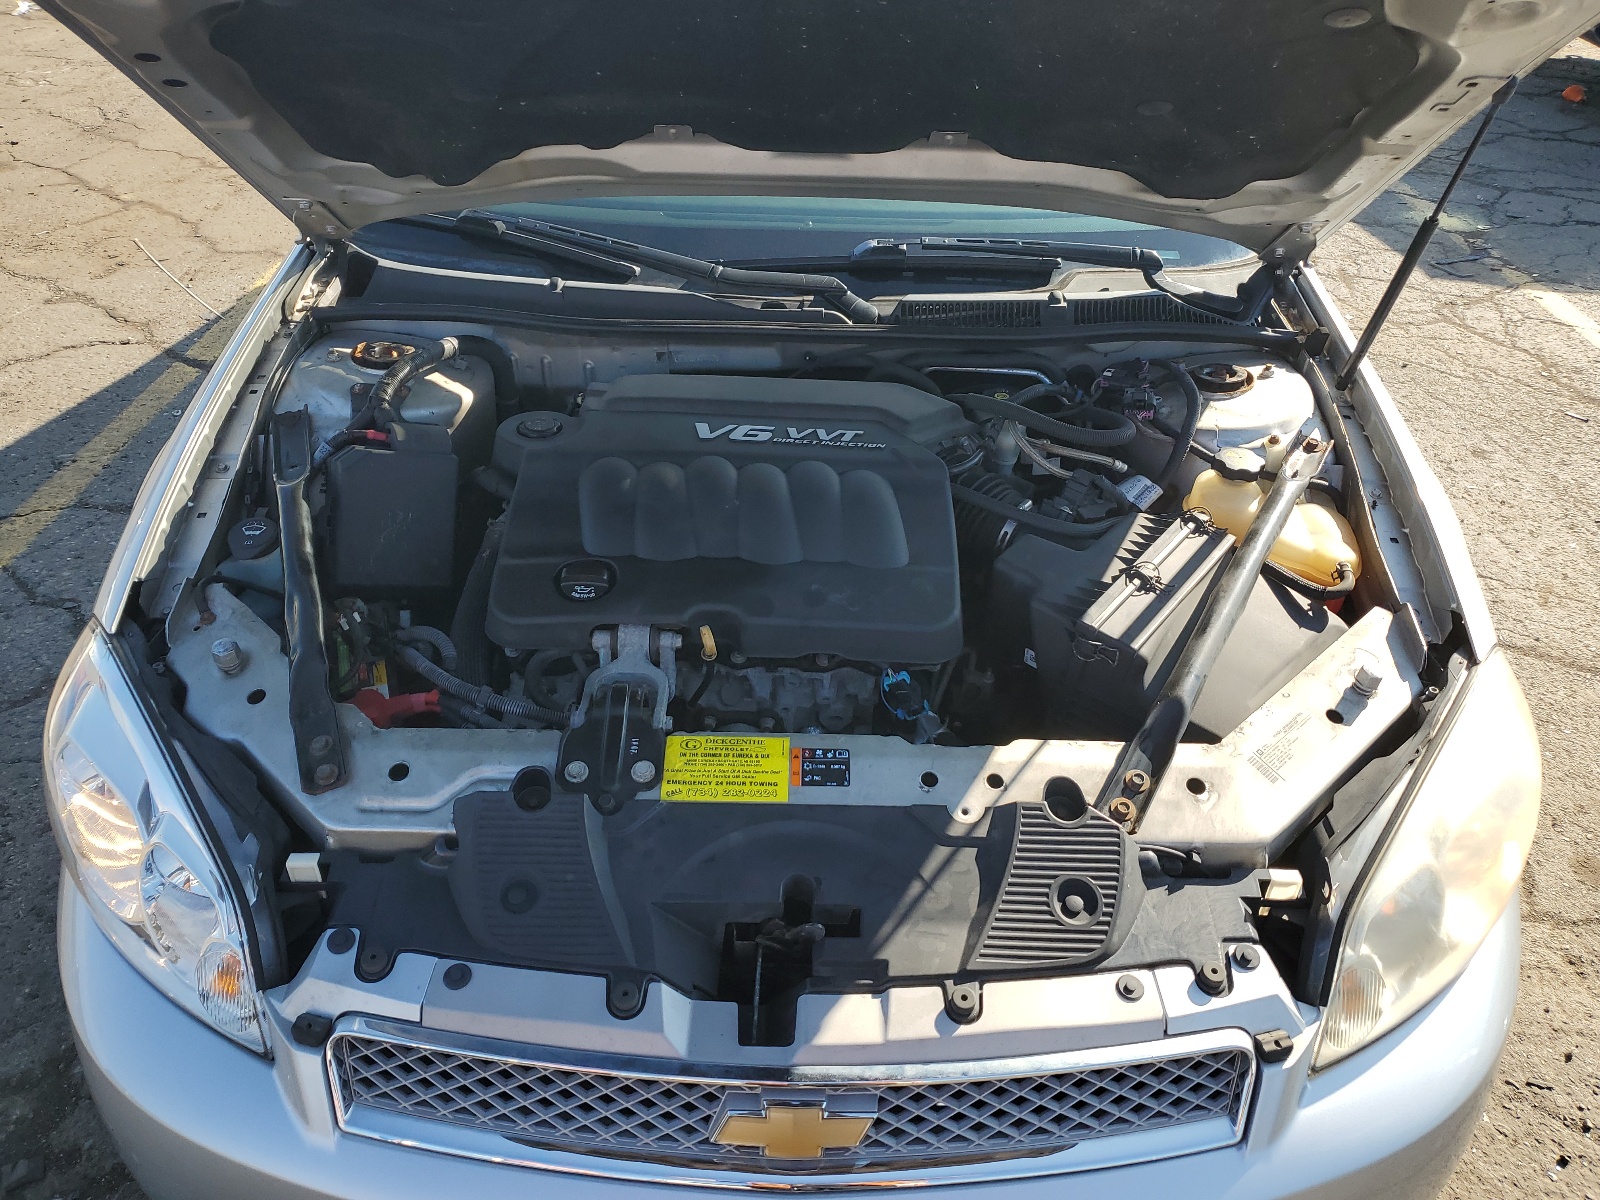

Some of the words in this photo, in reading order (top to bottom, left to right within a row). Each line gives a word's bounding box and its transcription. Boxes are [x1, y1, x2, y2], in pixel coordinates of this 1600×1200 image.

[695, 422, 775, 441] V6
[787, 427, 864, 442] VVT
[666, 788, 683, 797] CALL
[686, 788, 718, 798] (734)
[722, 788, 777, 797] 282-0224
